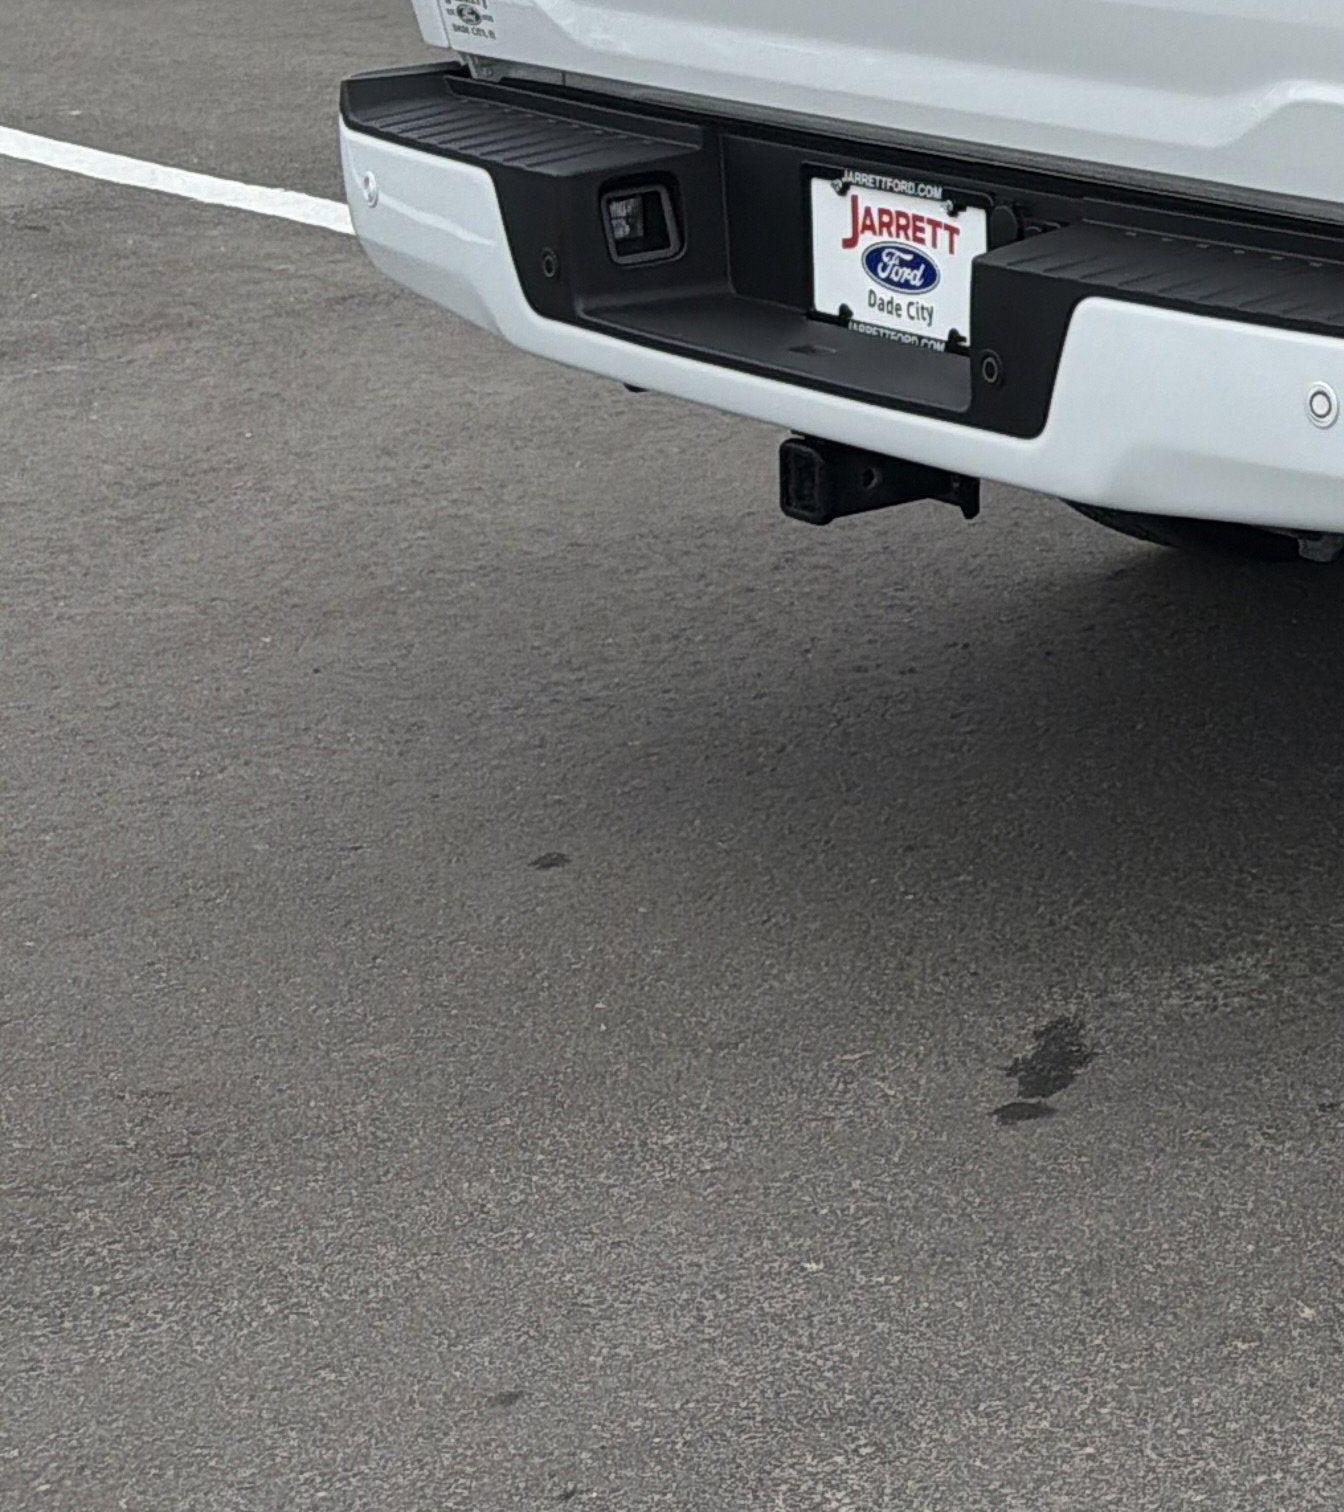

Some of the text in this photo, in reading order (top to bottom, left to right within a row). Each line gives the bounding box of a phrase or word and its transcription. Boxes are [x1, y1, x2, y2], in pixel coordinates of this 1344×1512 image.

[842, 169, 942, 199] JARRETTFORD.COM
[842, 195, 960, 255] JARRETT
[877, 247, 926, 286] Ford
[868, 289, 934, 326] Dade City
